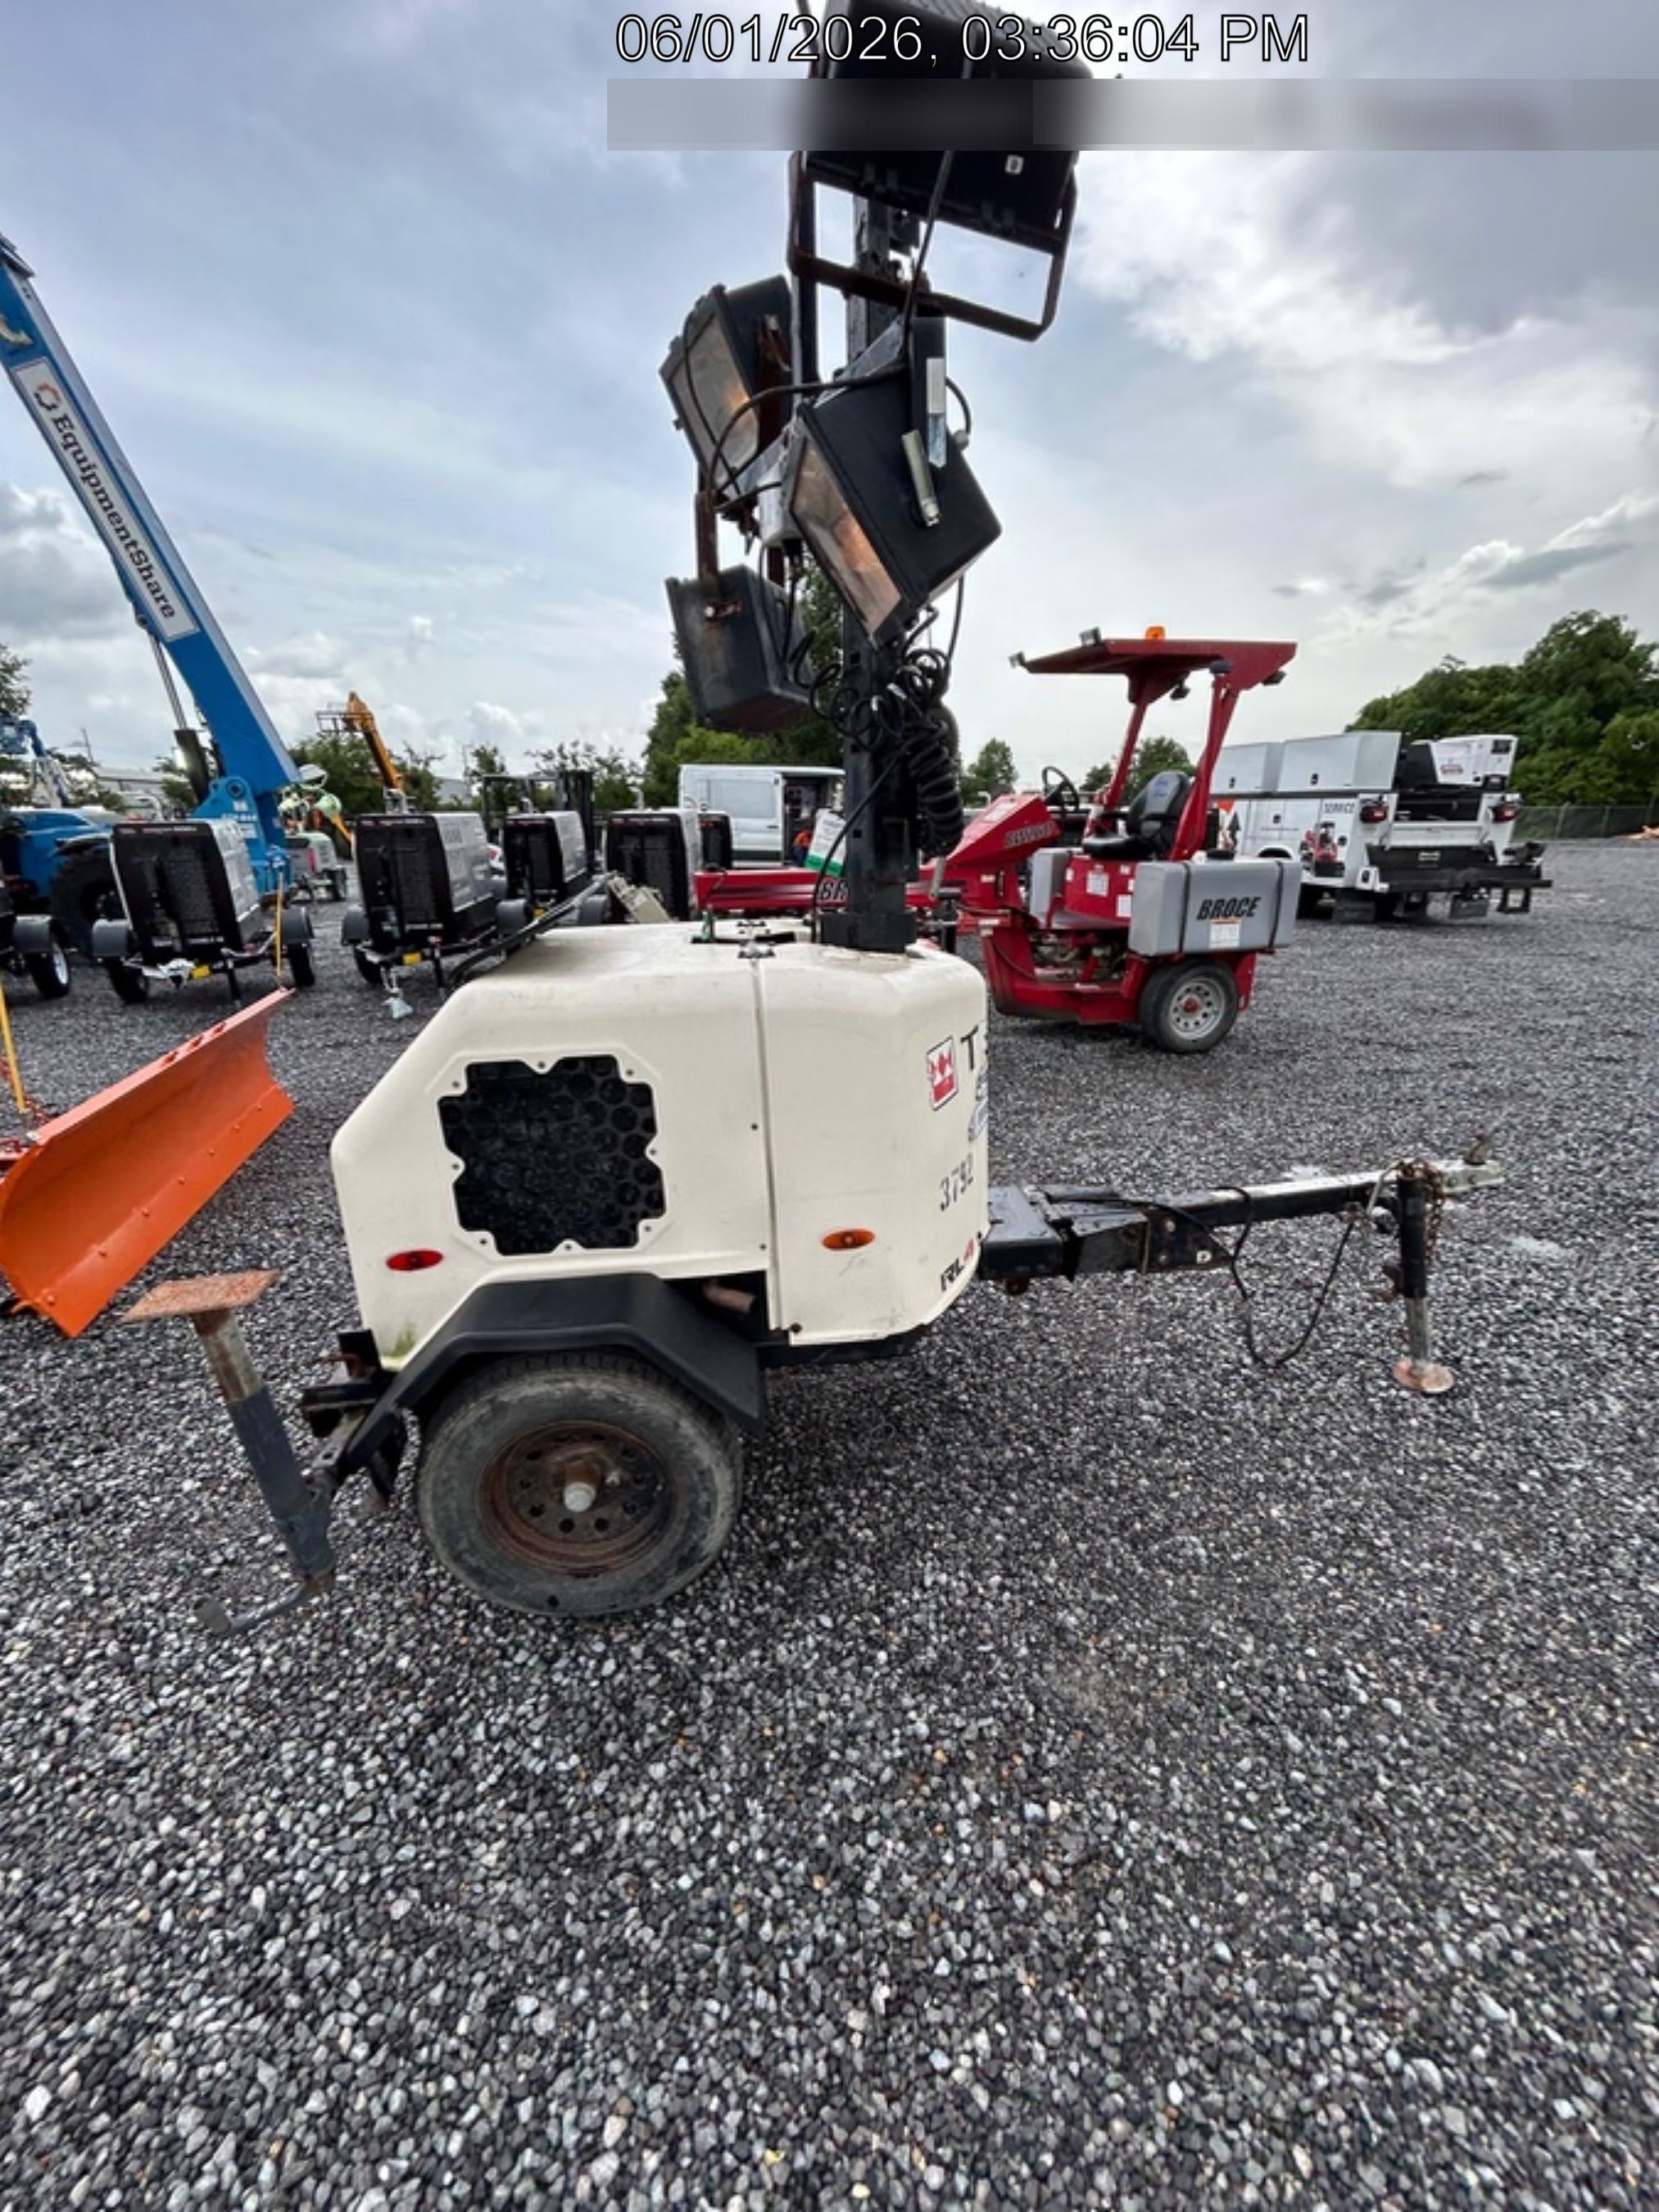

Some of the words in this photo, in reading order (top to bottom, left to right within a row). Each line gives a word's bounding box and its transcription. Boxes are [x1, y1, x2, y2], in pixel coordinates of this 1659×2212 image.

[52, 412, 176, 619] EquipmentShare
[1196, 896, 1262, 920] BROCE
[940, 1151, 974, 1213] 3792
[941, 1238, 974, 1293] RL4
